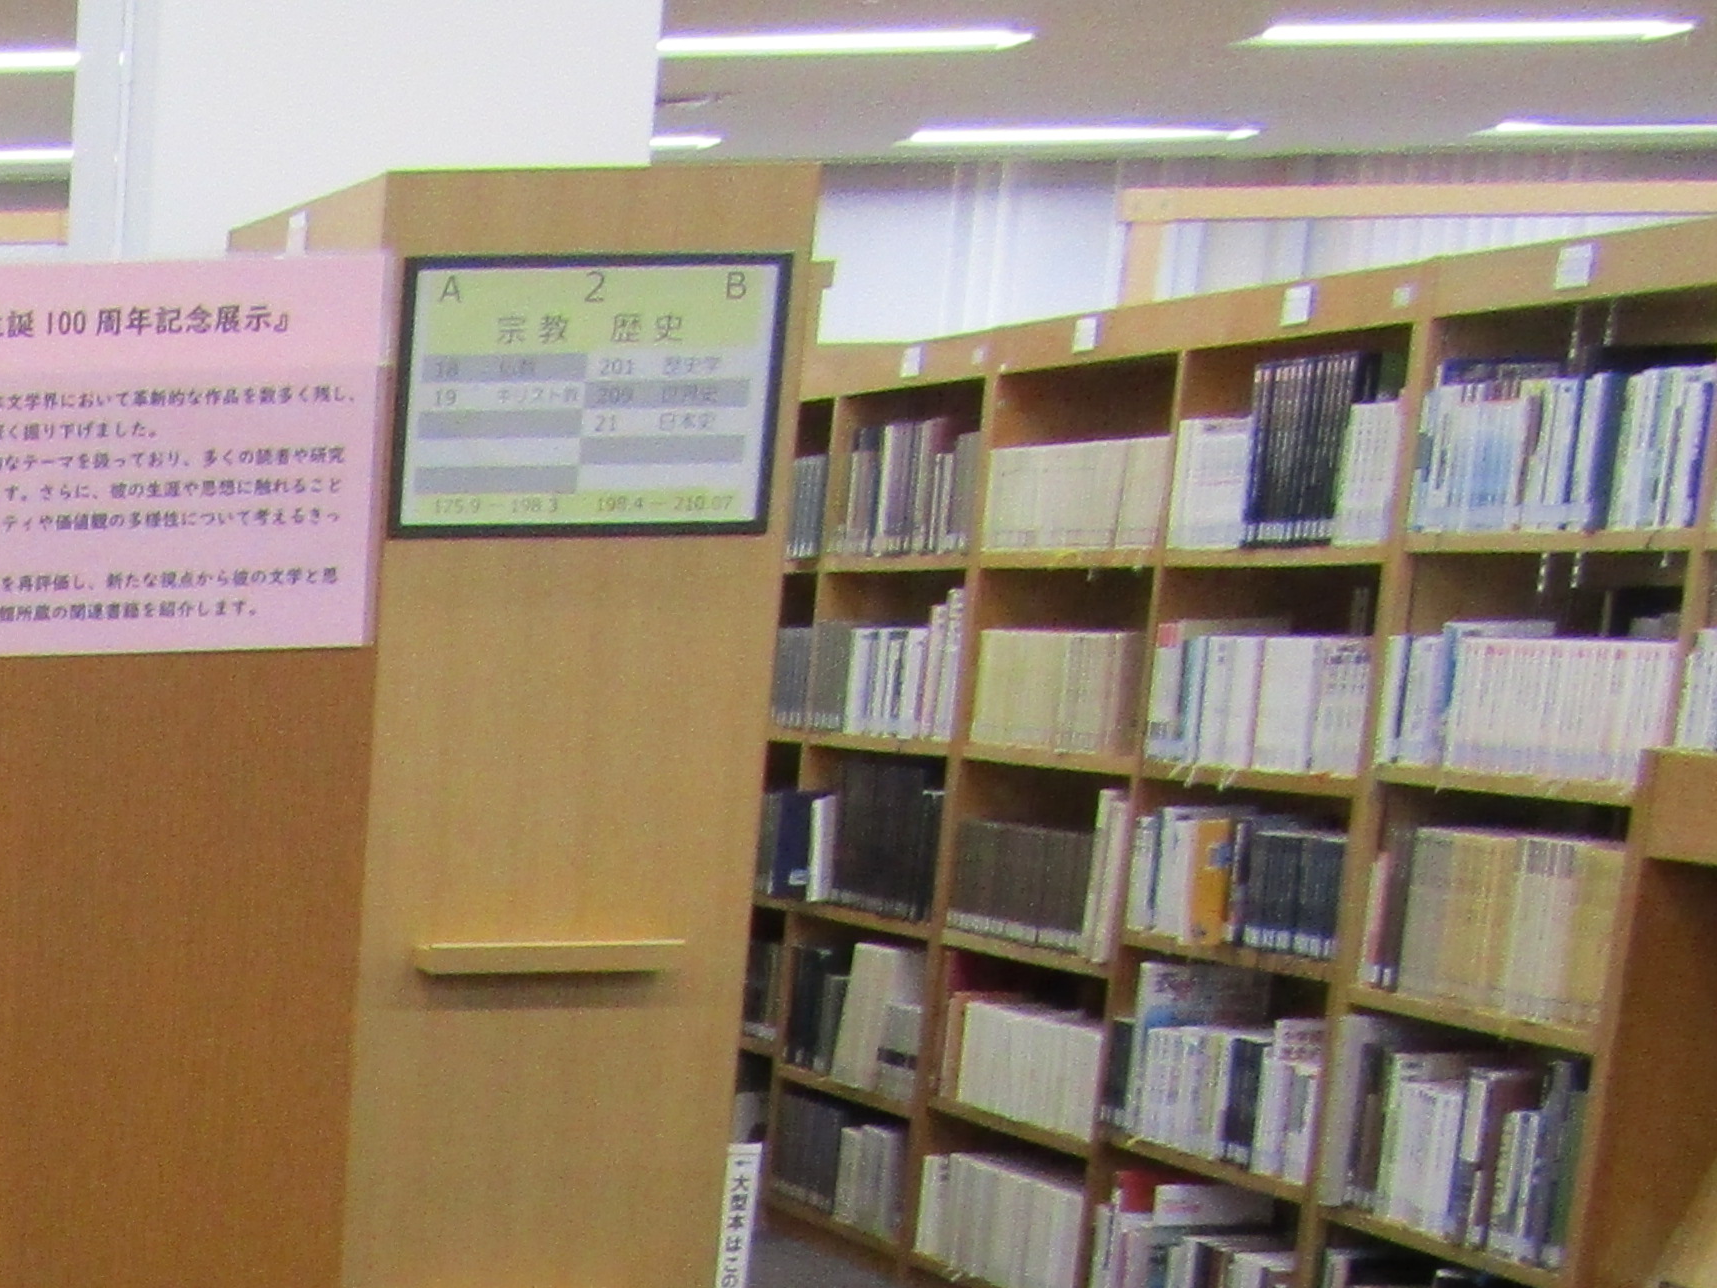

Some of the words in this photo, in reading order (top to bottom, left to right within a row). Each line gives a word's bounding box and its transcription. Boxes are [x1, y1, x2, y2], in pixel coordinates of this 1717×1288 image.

[439, 274, 462, 304] A
[584, 271, 606, 302] 2
[726, 271, 747, 299] B
[496, 315, 570, 344] 宗教
[610, 312, 684, 344] 歴史
[435, 389, 457, 407] 19
